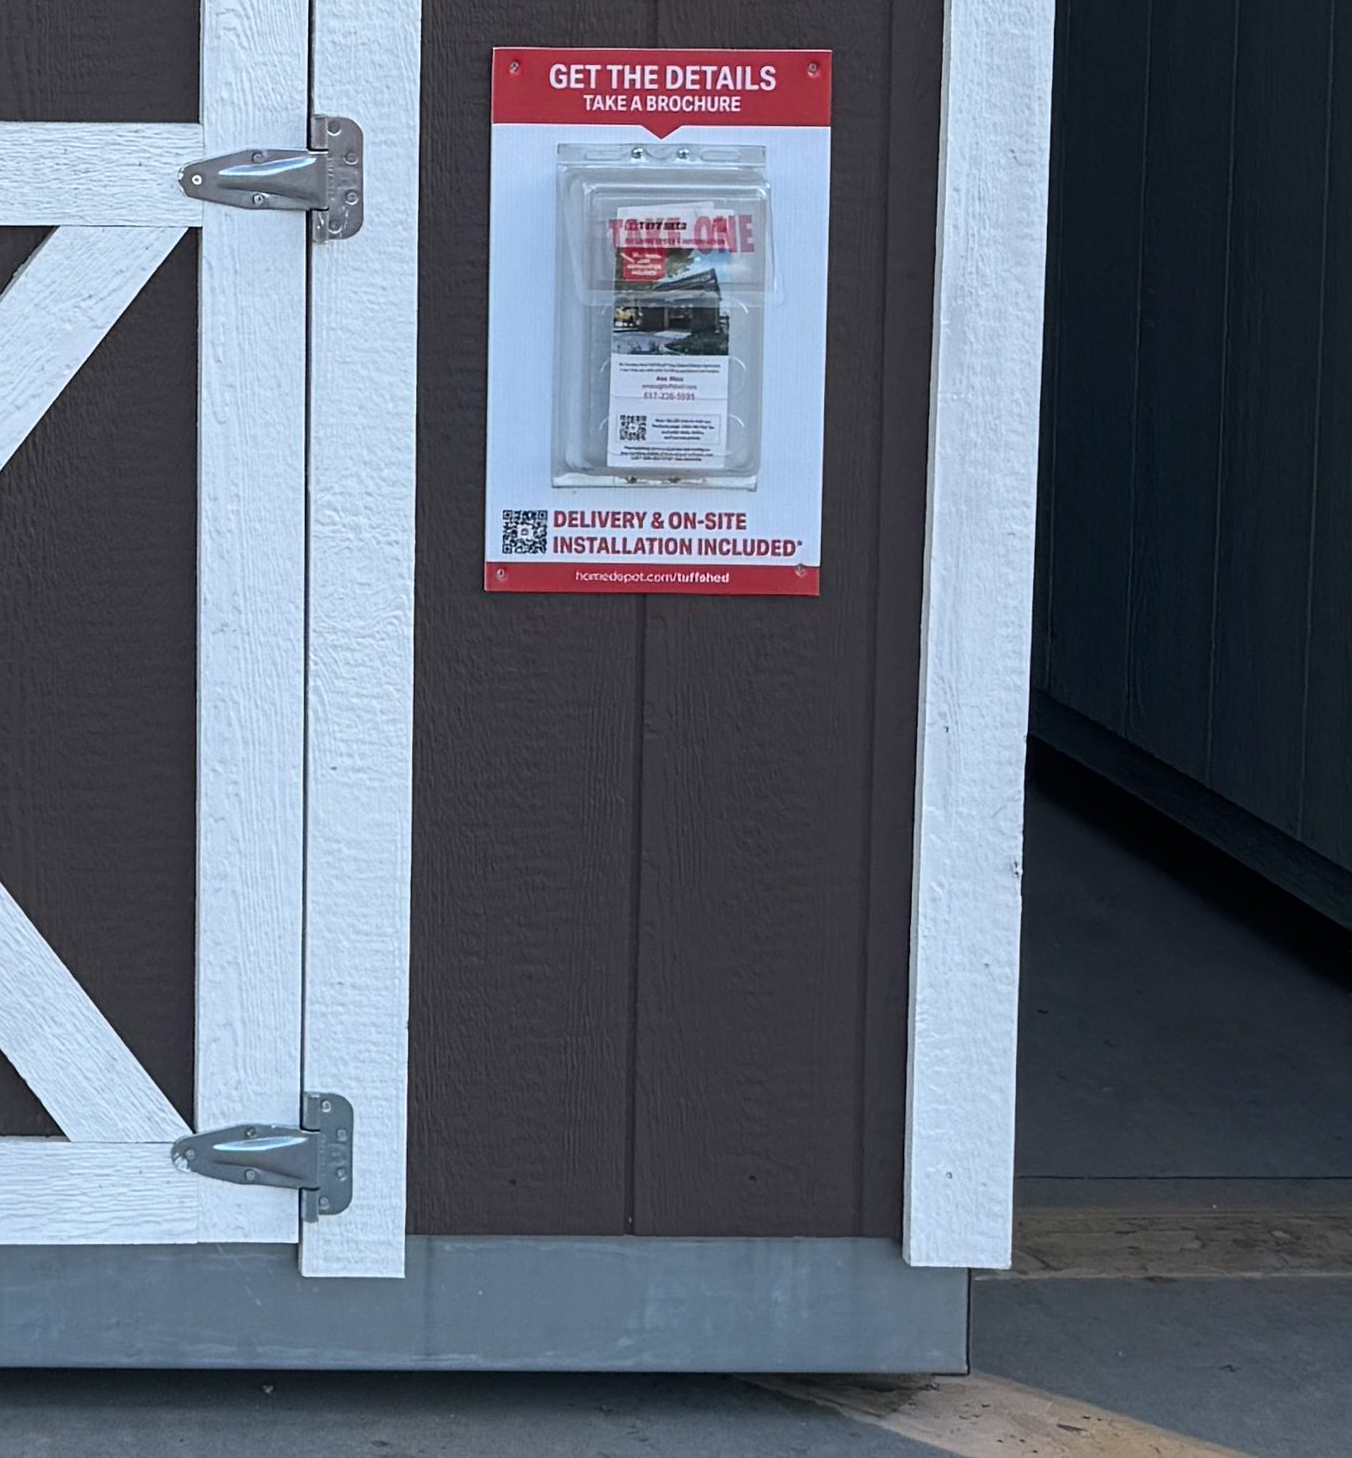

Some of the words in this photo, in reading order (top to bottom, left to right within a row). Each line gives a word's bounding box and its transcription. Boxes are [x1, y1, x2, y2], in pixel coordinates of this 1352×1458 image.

[548, 63, 601, 89] GET
[606, 64, 658, 90] THE
[665, 65, 777, 91] DETAILS
[583, 94, 627, 112] TAKE
[629, 95, 643, 112] A
[646, 95, 741, 112] BROCHURE
[693, 214, 755, 254] ONE
[553, 510, 649, 530] DELIVERY
[649, 511, 665, 530] &
[668, 511, 747, 531] ON-SITE
[552, 536, 693, 556] INSTALLATION
[575, 570, 730, 584] homedepot.com/tuffshed
